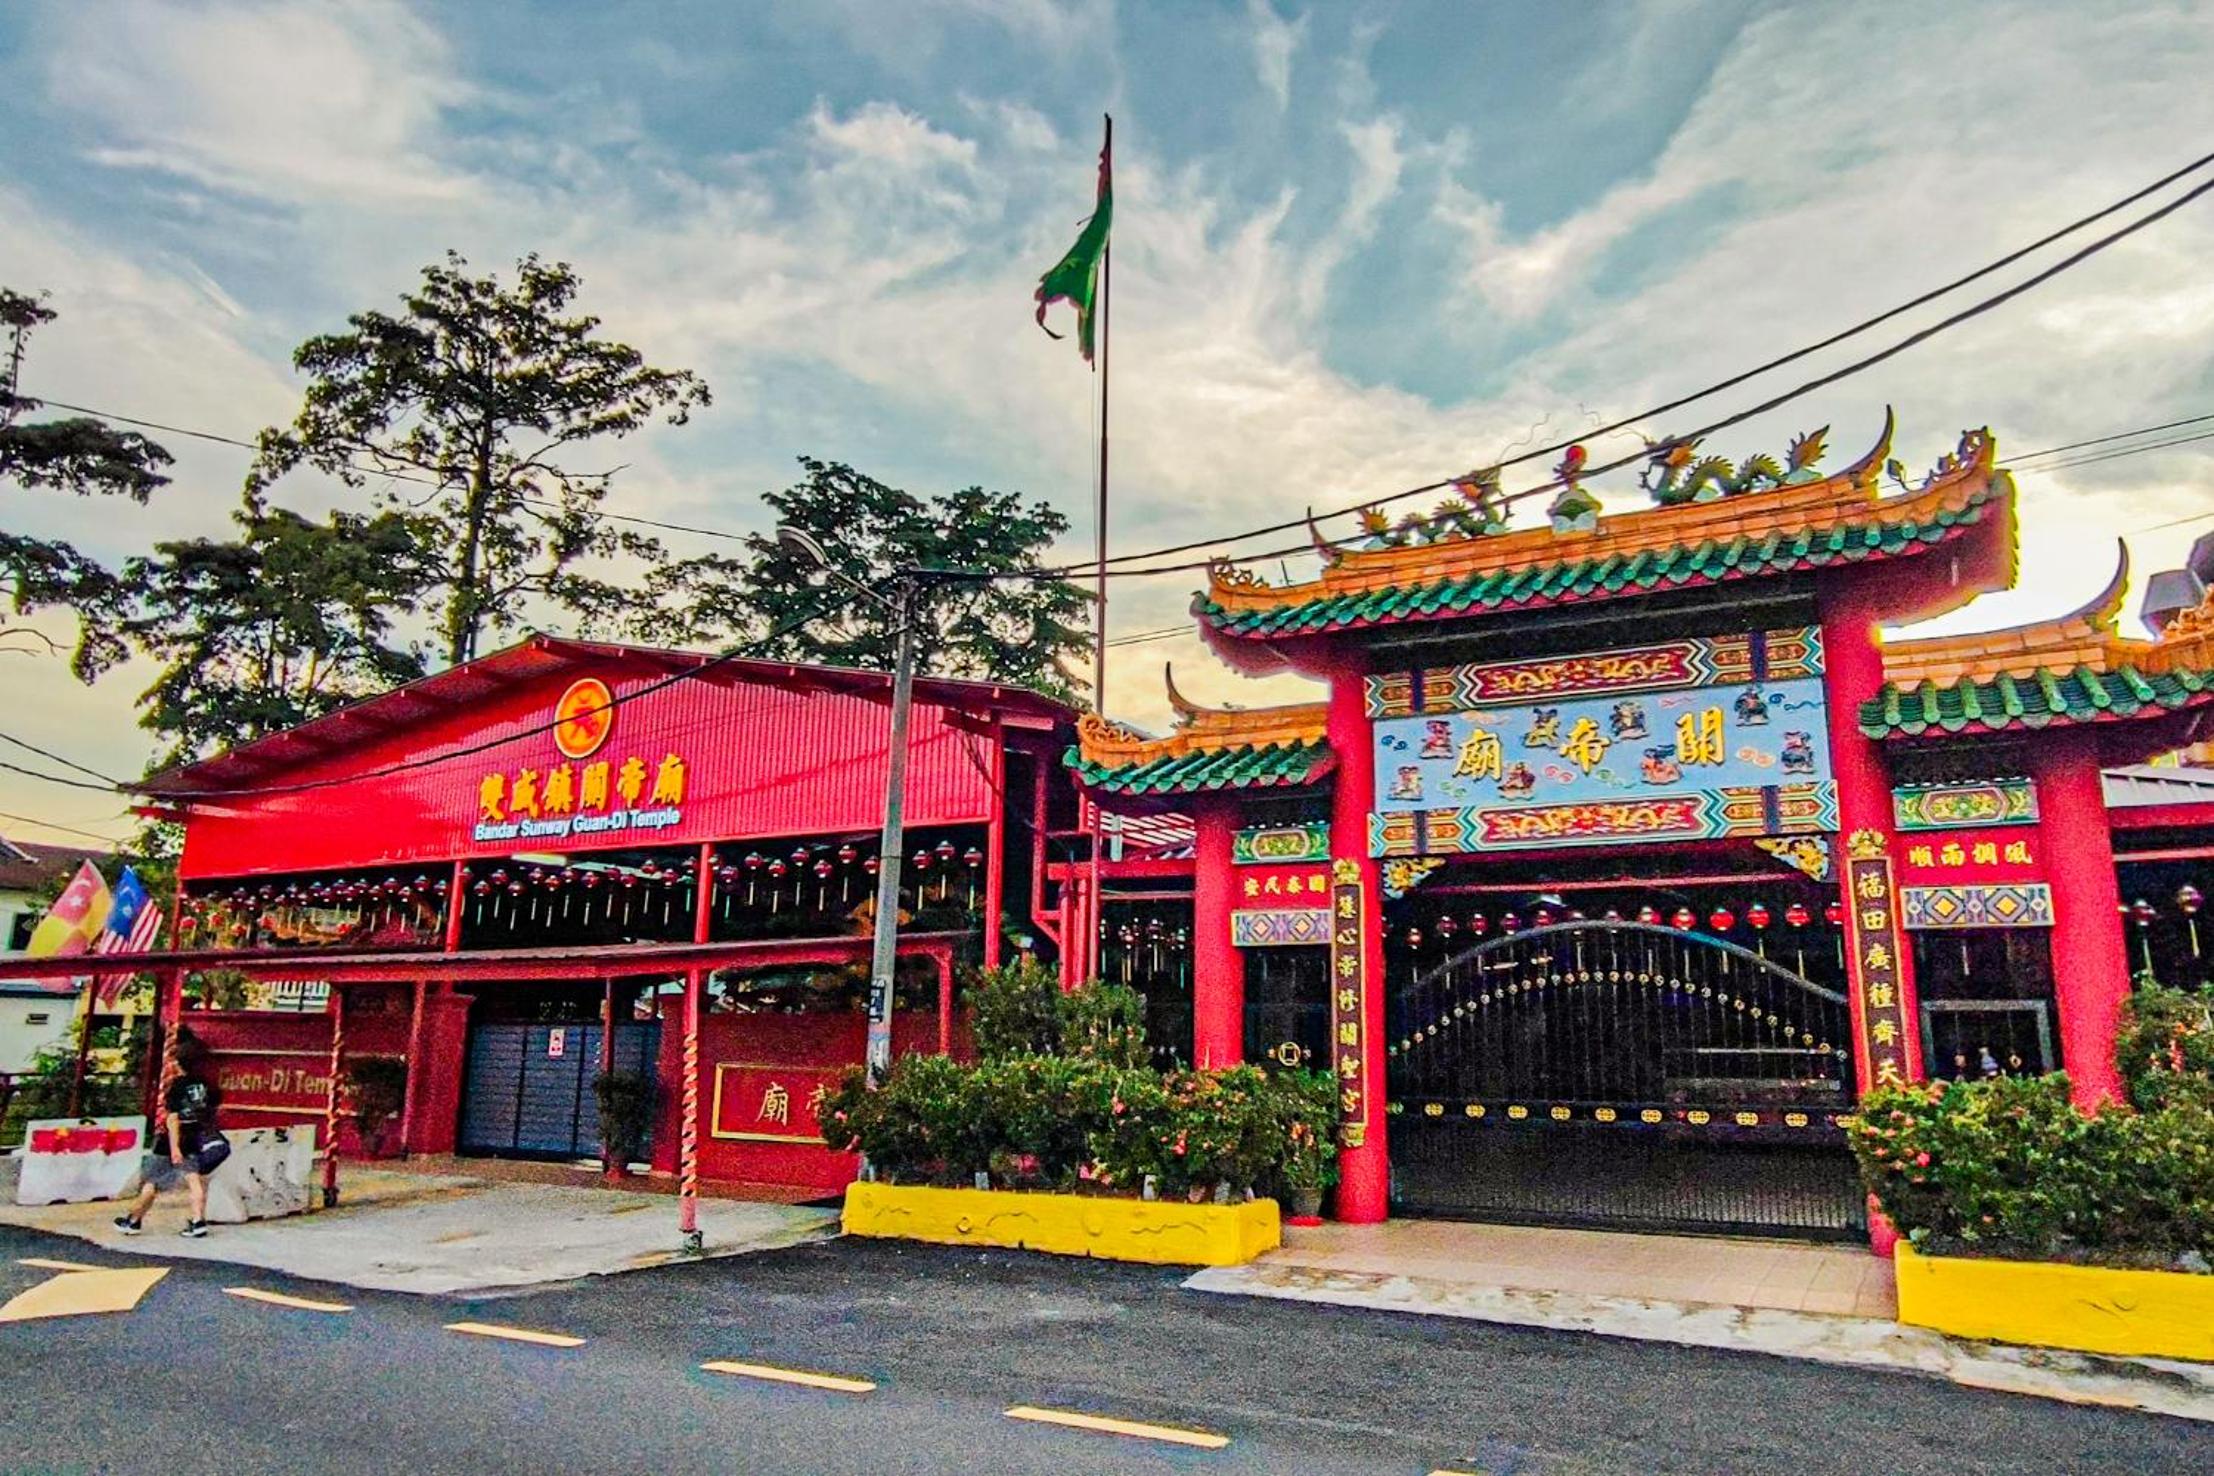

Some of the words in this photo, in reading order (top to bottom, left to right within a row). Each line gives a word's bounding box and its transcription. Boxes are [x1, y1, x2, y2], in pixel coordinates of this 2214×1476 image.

[474, 822, 518, 841] Bandar
[520, 817, 572, 838] Sunway
[630, 807, 681, 830] Temple
